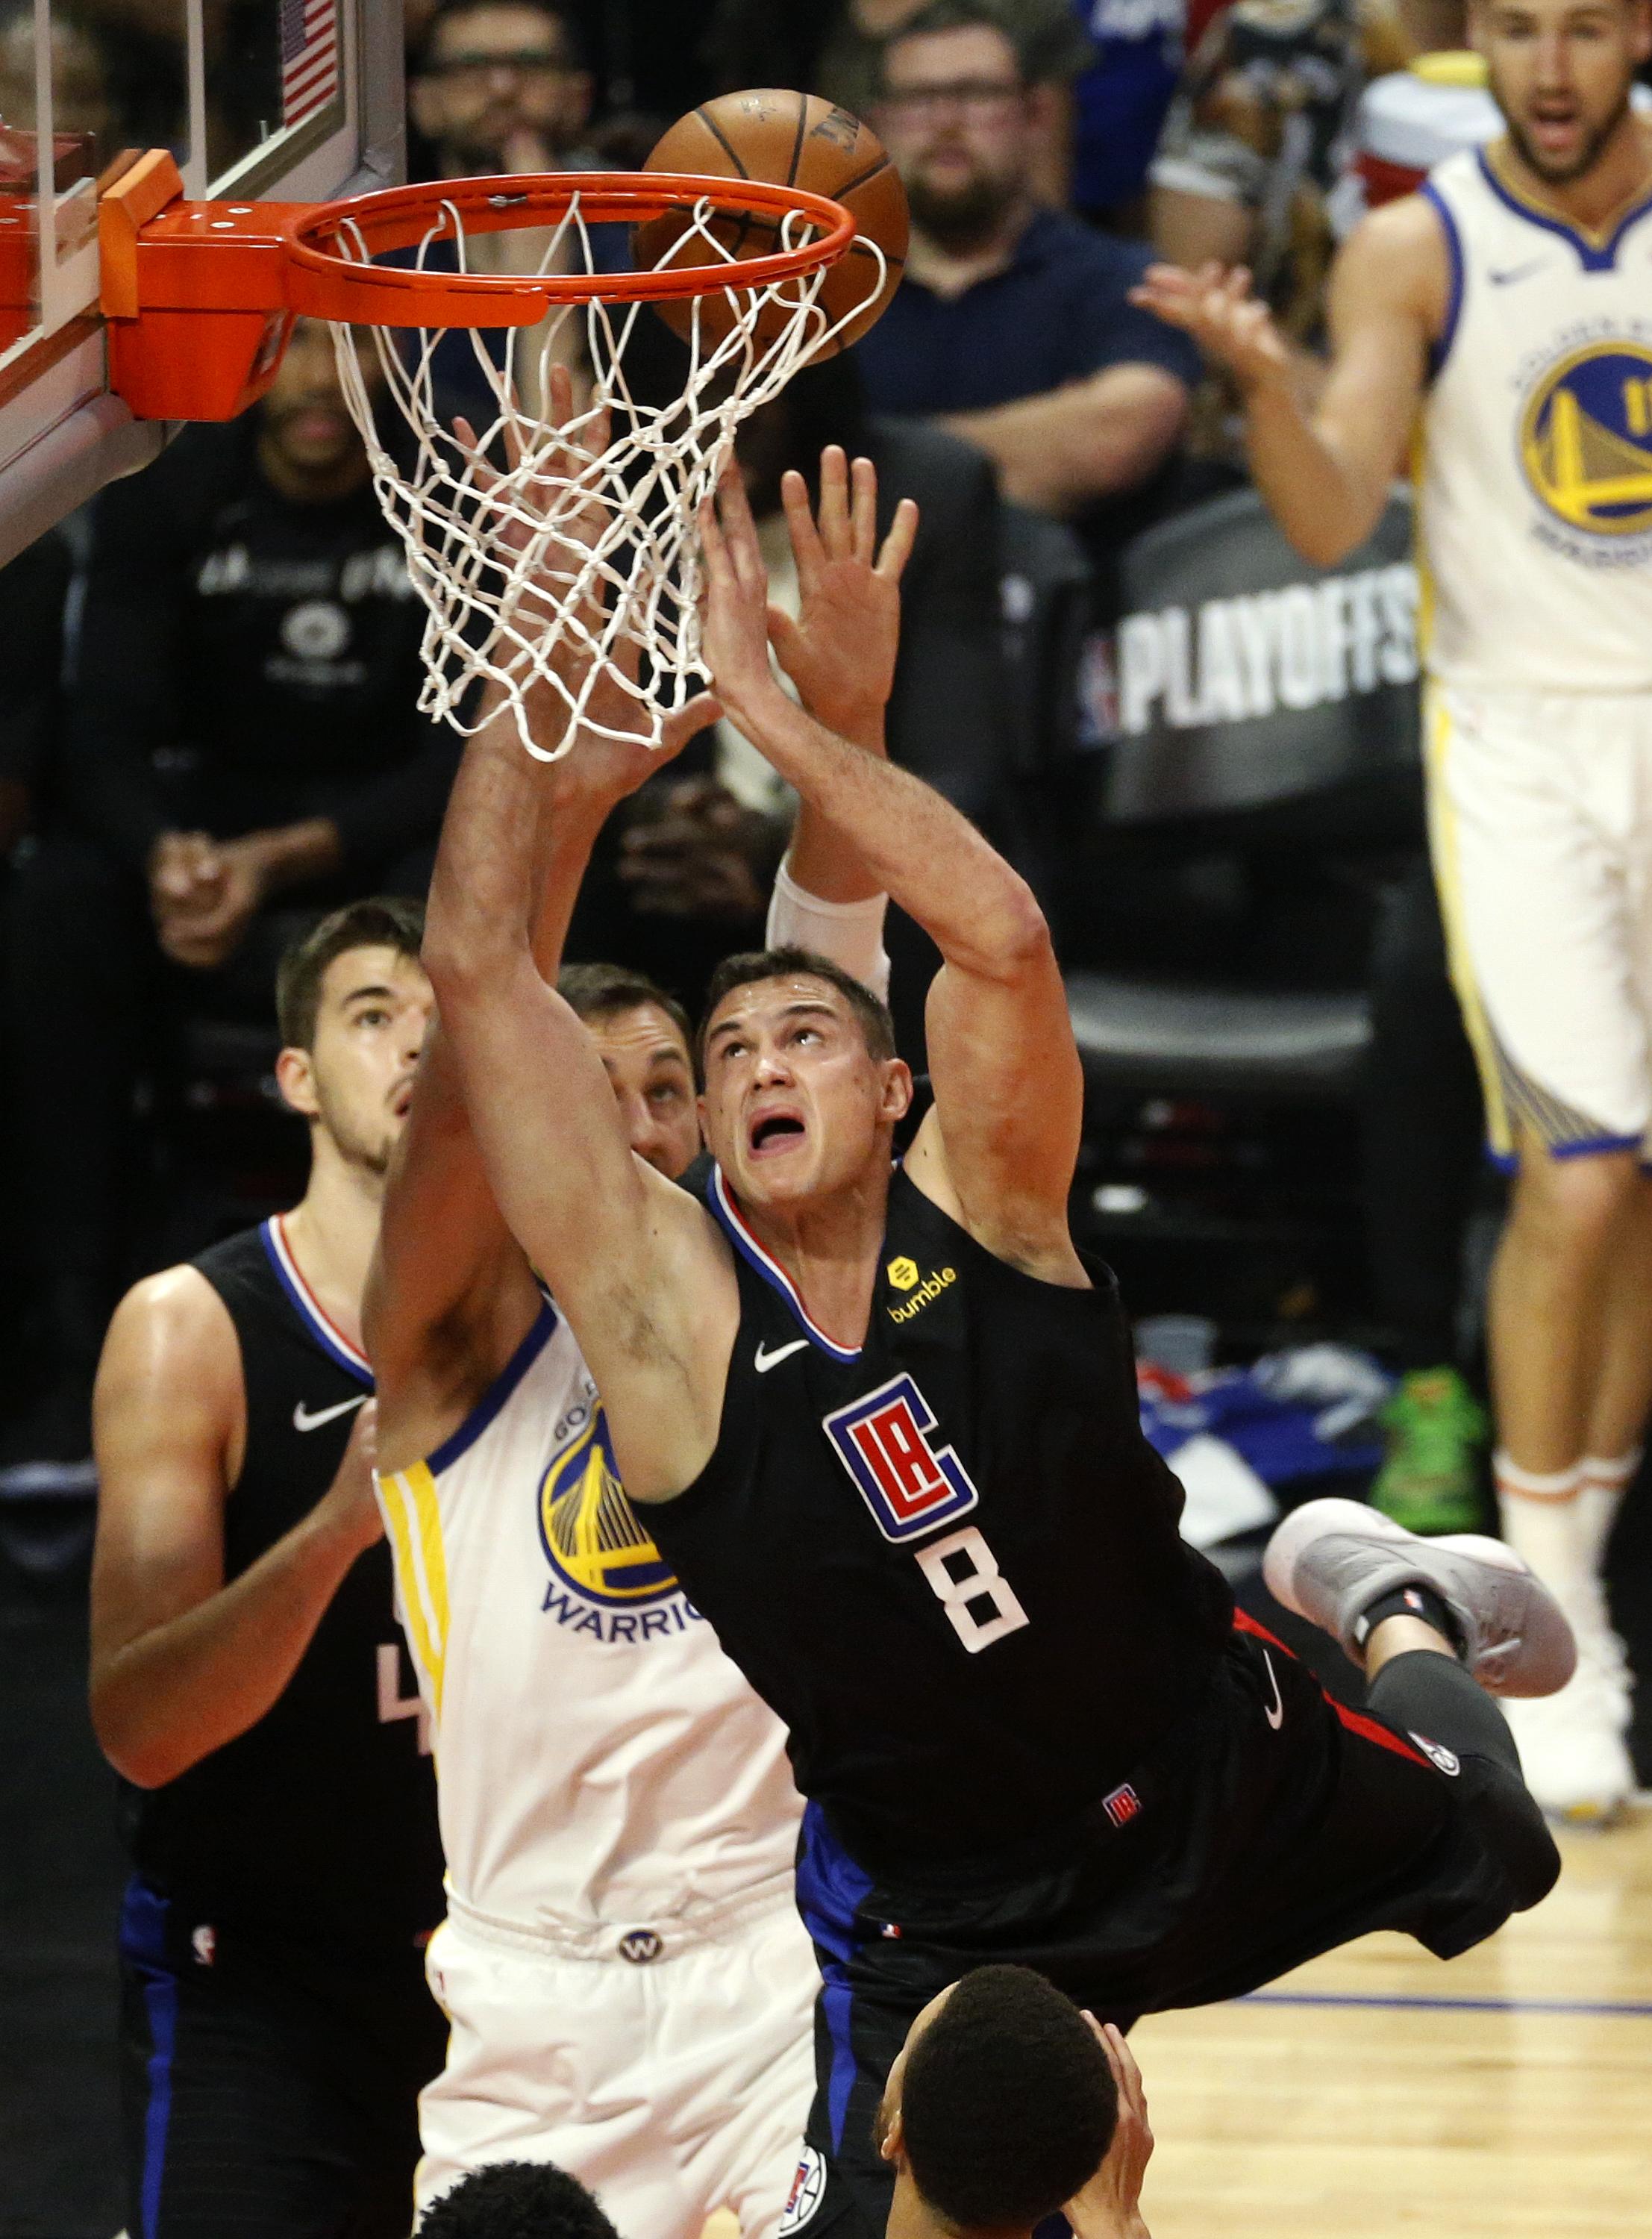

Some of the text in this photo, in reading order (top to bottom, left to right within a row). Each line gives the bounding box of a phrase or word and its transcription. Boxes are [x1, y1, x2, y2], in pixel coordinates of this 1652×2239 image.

[1121, 562, 1418, 734] PLAYOFFS
[886, 1267, 956, 1324] bumble
[914, 1526, 1030, 1654] 8
[623, 1936, 657, 1960] W
